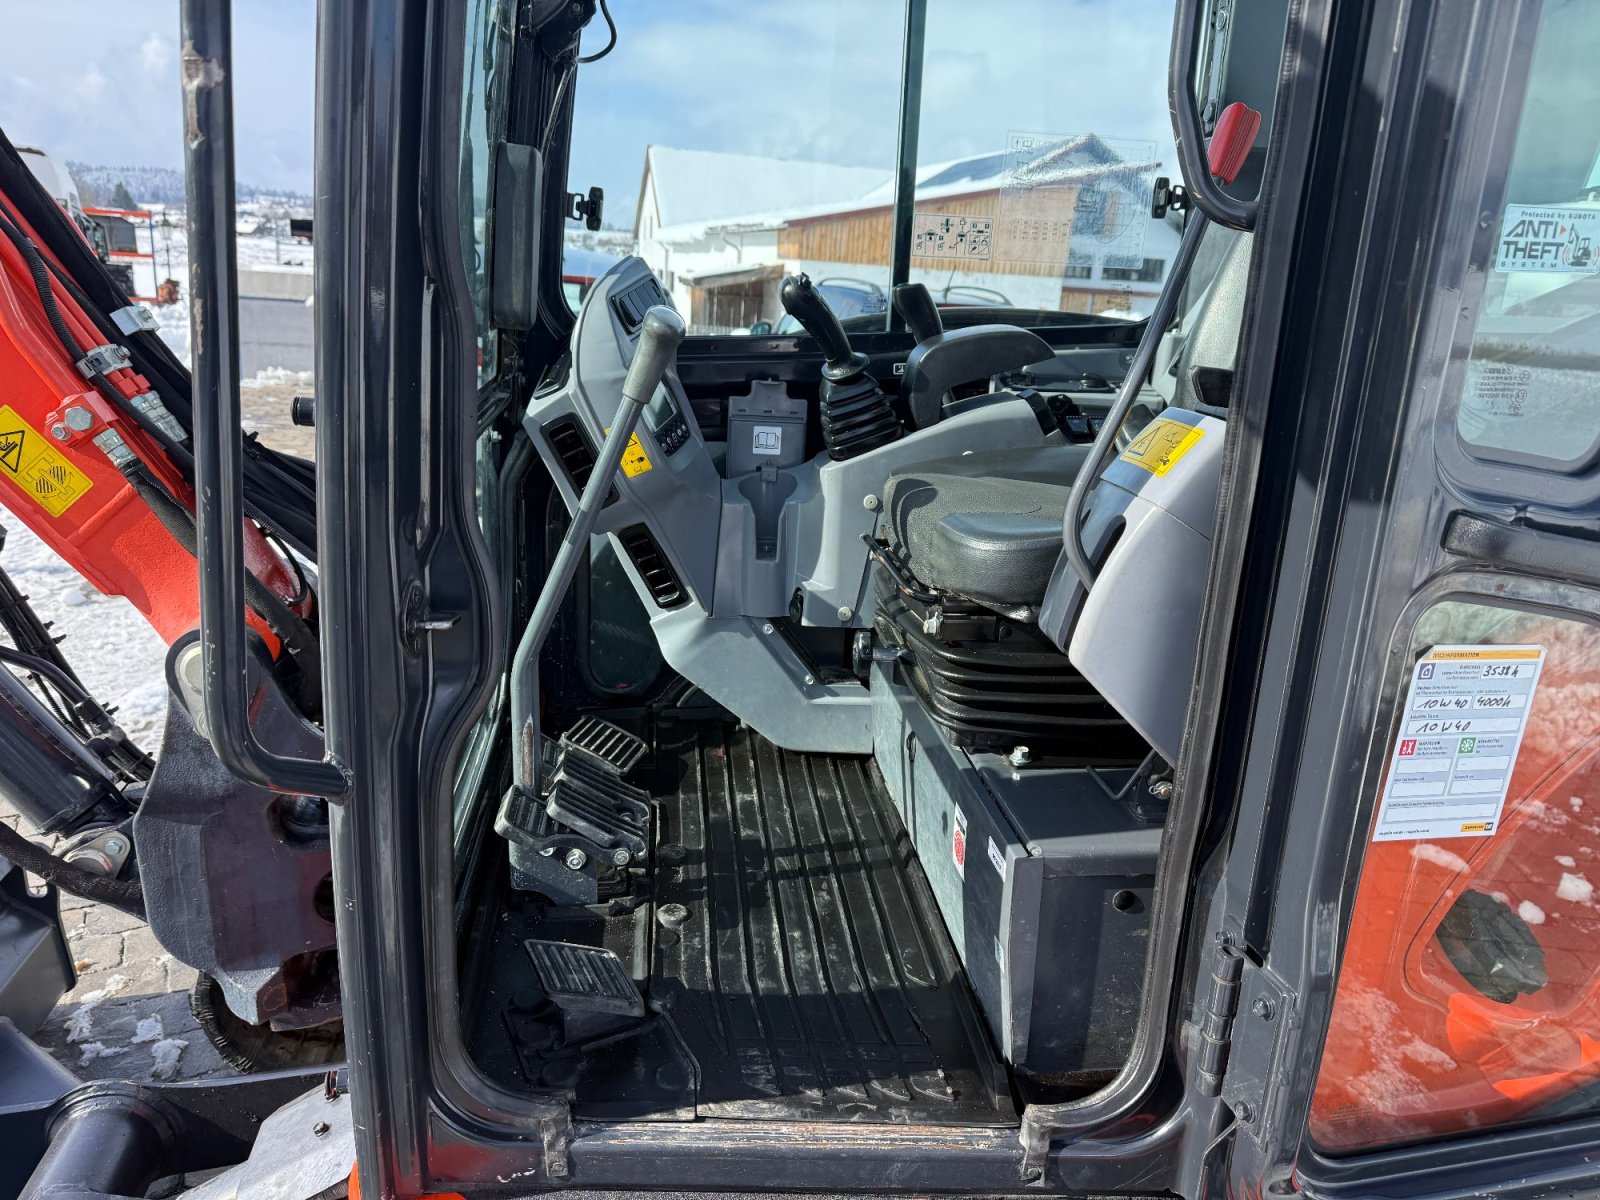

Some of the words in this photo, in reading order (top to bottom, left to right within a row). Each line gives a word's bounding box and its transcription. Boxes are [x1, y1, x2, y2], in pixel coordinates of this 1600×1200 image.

[1521, 211, 1555, 219] Protected
[1557, 212, 1565, 220] by
[1568, 212, 1596, 220] KUBOTA
[1505, 220, 1558, 239] ANTI
[1503, 241, 1564, 260] THEFT
